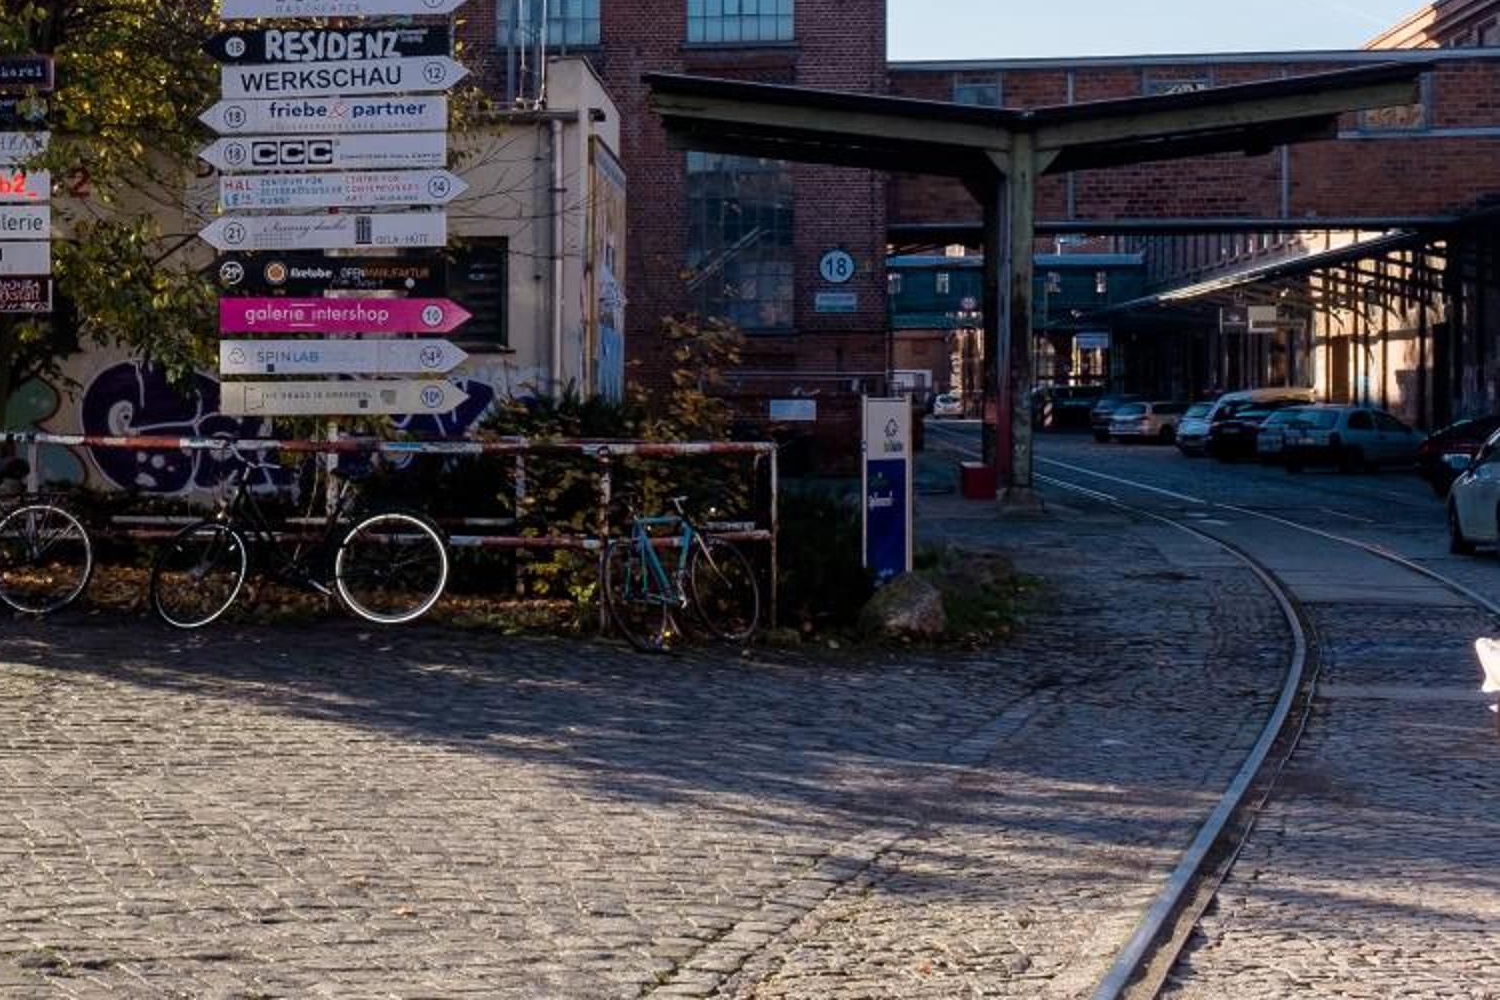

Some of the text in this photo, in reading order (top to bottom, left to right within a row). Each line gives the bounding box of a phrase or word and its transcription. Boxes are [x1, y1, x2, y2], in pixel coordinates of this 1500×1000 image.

[265, 29, 400, 61] RESIDENZ
[241, 66, 401, 92] WERKSCHAU
[426, 67, 441, 79] 12
[269, 101, 328, 118] friebe
[352, 102, 427, 119] partner
[252, 140, 333, 165] CCC
[432, 180, 446, 192] 14
[227, 227, 242, 239] 21
[826, 256, 847, 277] 18
[245, 304, 389, 326] galerie intershop
